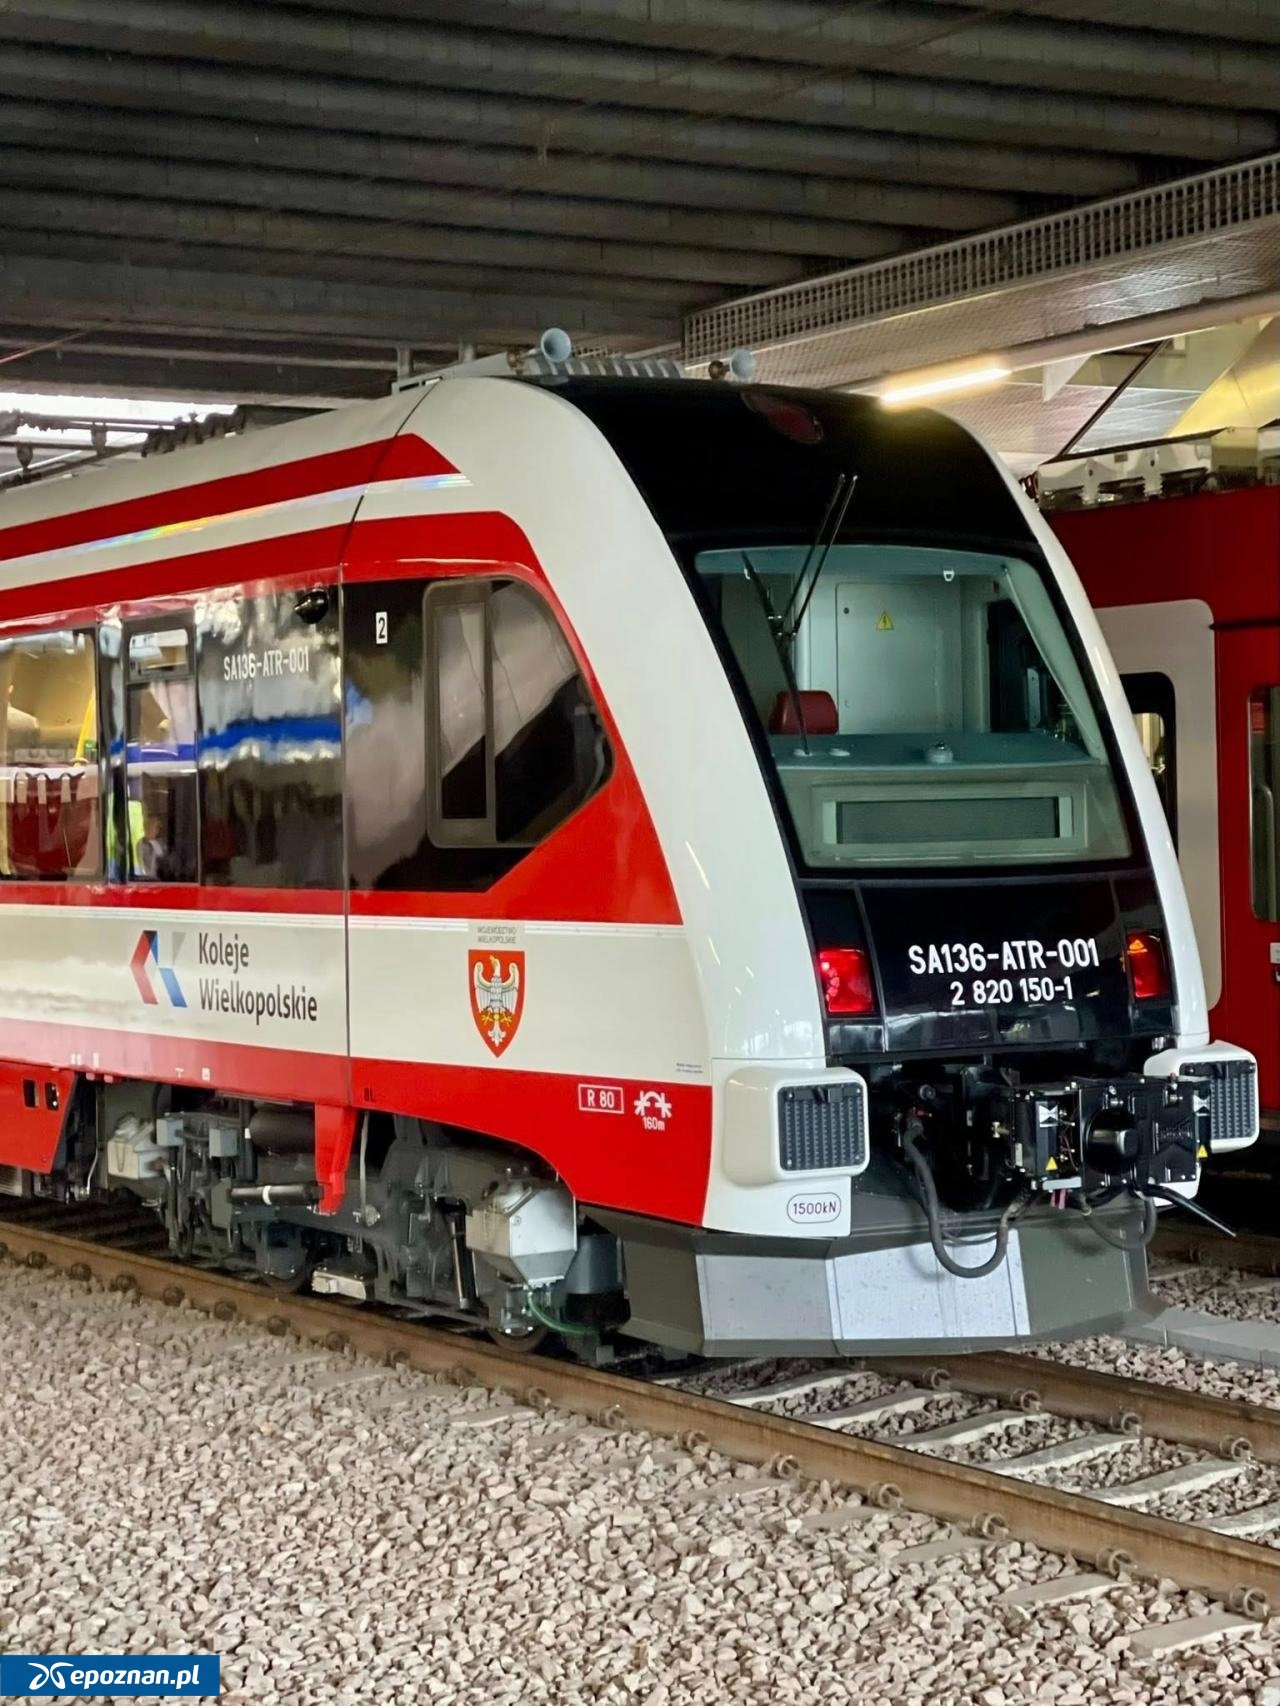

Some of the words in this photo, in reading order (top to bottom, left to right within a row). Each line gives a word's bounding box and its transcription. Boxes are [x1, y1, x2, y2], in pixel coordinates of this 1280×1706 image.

[378, 617, 386, 639] 2
[223, 646, 309, 681] SA136-ATR-001
[199, 932, 249, 974] Koleje
[908, 938, 1100, 974] SA136-ATR-001
[199, 978, 318, 1026] Wielkopolskie
[950, 981, 965, 1006] 2
[972, 978, 1013, 1004] 820
[1019, 976, 1073, 1002] 150-1
[587, 1089, 595, 1108] R
[599, 1091, 615, 1109] 80
[643, 1116, 665, 1131] 160m
[793, 1201, 836, 1215] 1500kN
